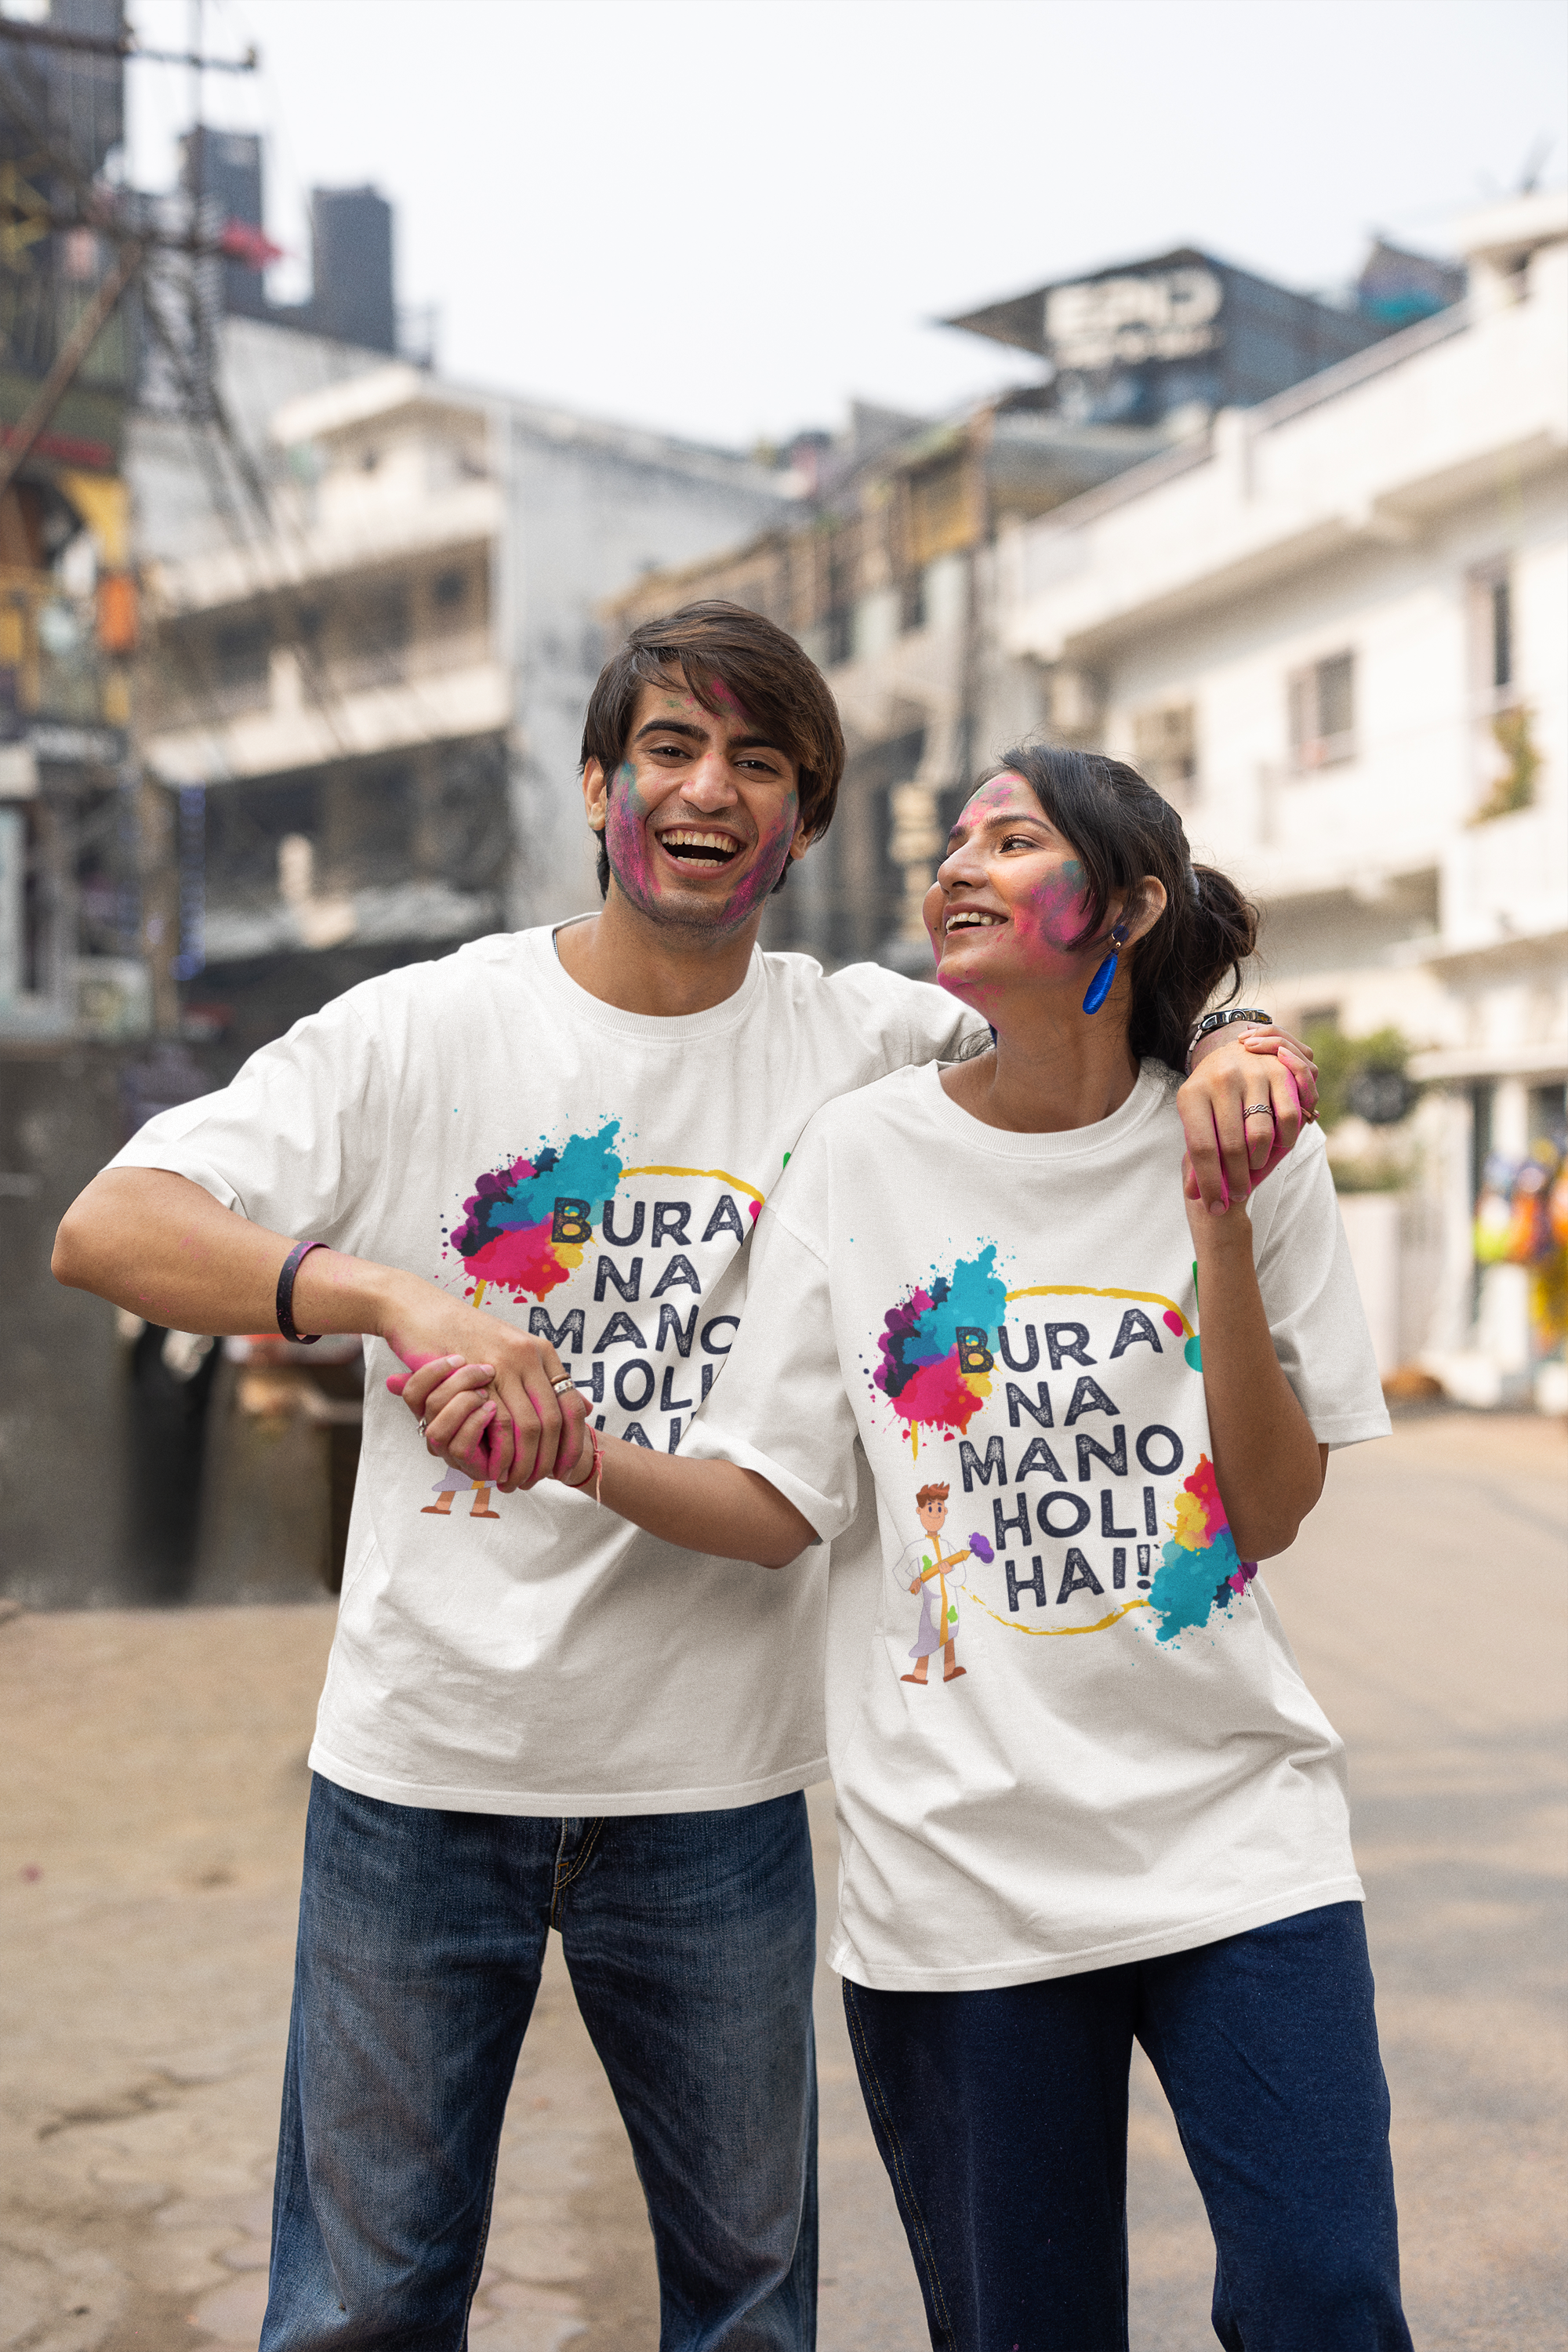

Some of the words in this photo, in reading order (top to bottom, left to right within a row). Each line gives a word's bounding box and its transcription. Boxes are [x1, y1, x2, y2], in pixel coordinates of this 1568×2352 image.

[551, 1195, 744, 1247] BURA
[593, 1254, 701, 1302] NA
[955, 1308, 1163, 1374] BURA
[1005, 1376, 1120, 1428] NA
[959, 1425, 1184, 1492] MANO
[993, 1486, 1158, 1550] HOLI
[1005, 1544, 1151, 1612] HAI!
